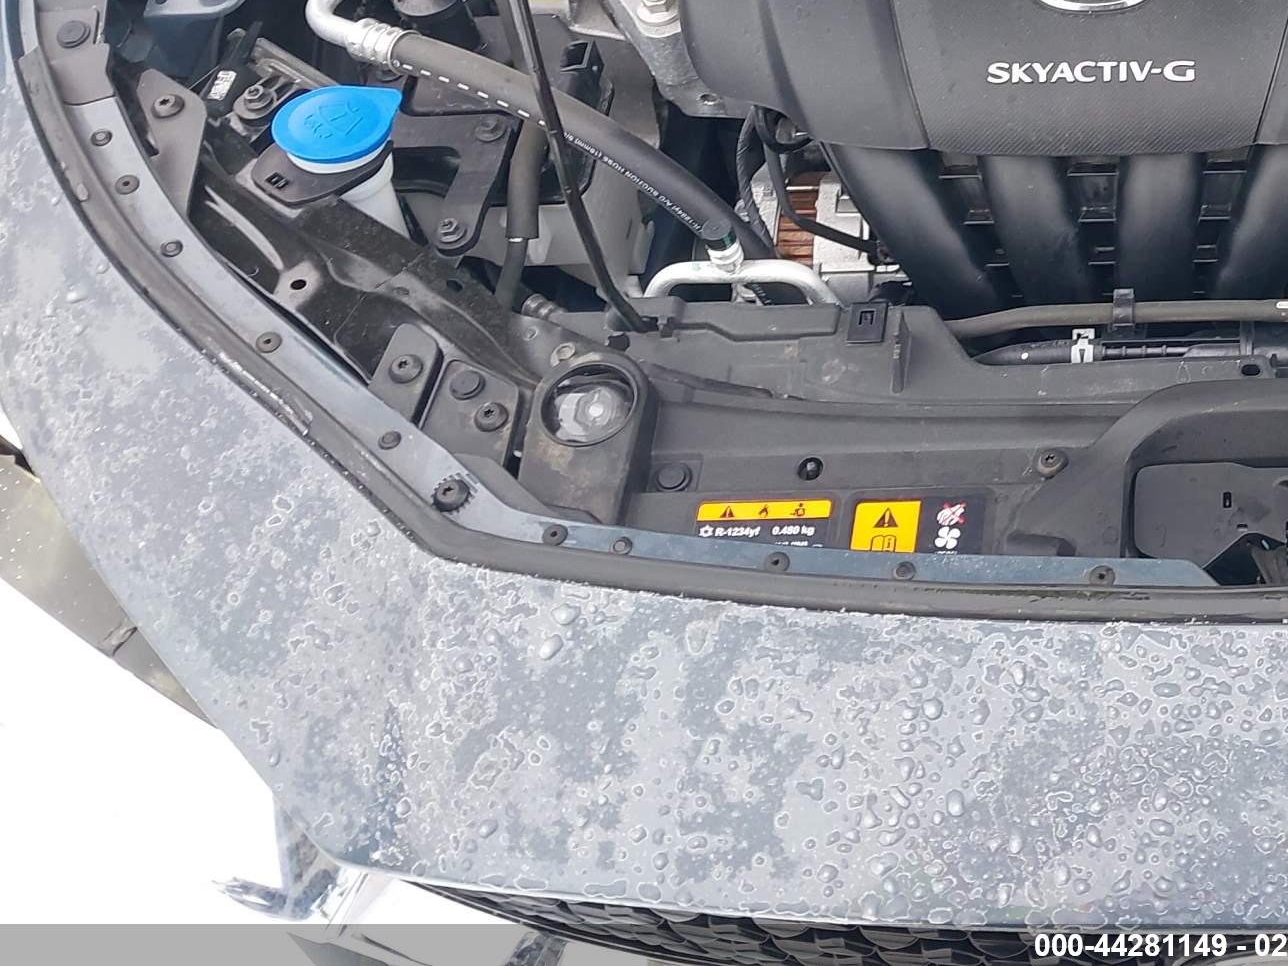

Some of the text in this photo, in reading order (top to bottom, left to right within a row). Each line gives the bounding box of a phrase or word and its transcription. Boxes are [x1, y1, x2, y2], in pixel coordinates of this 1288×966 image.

[986, 60, 1195, 84] SKYACTIV-G
[714, 526, 761, 538] R-1234yf
[801, 524, 816, 538] kg
